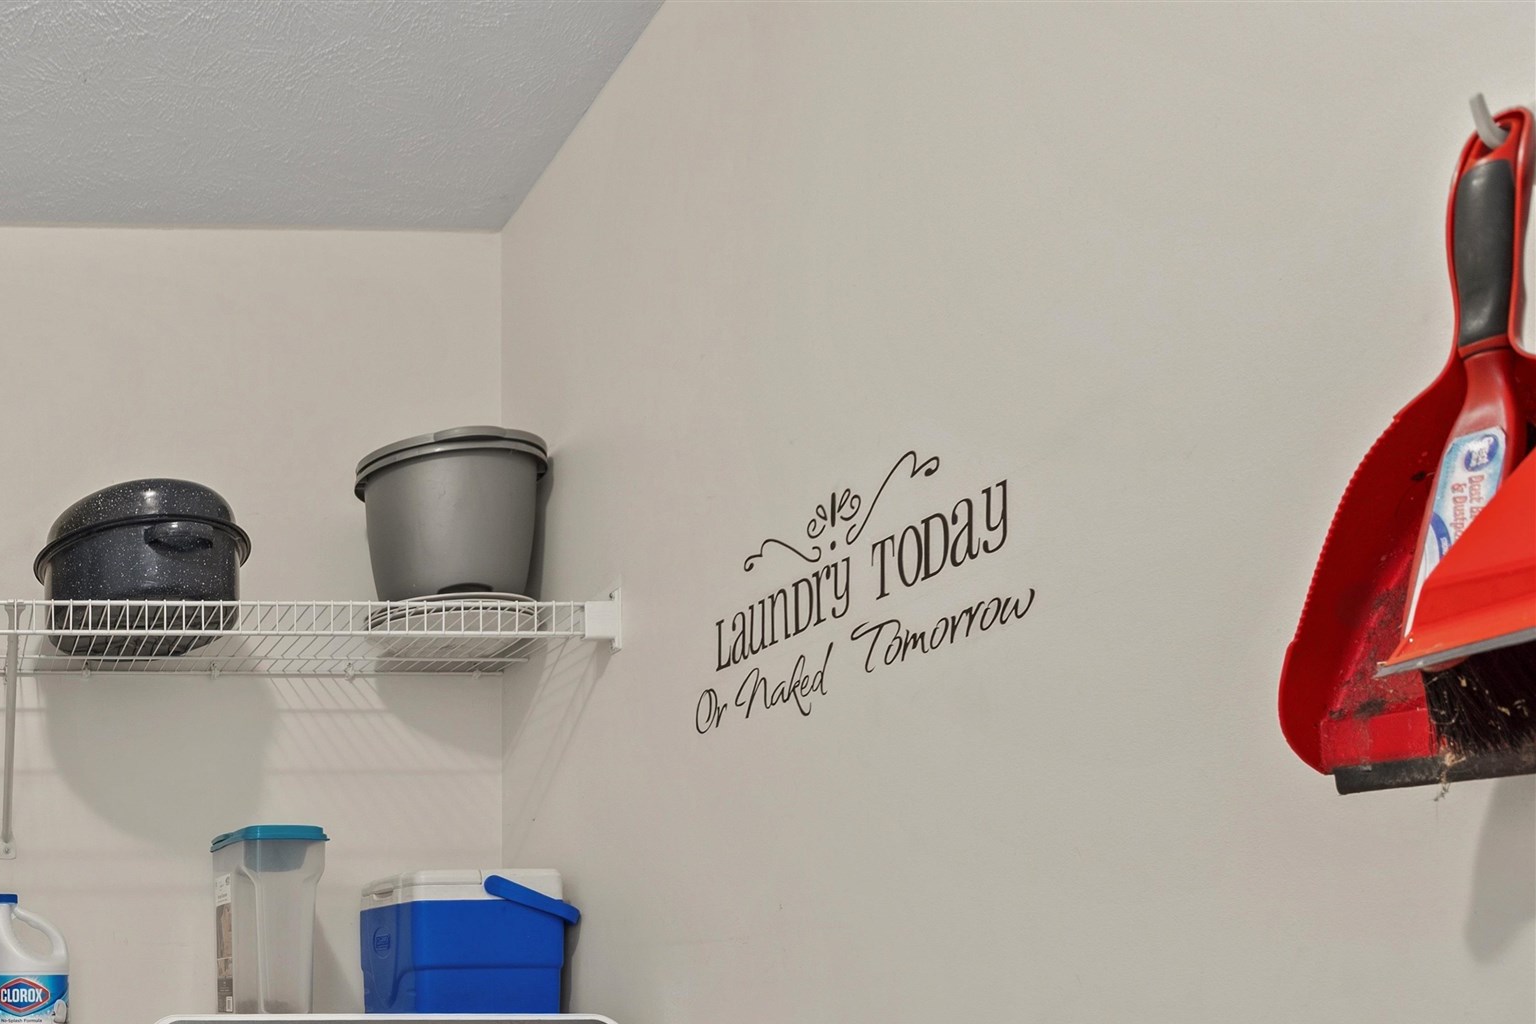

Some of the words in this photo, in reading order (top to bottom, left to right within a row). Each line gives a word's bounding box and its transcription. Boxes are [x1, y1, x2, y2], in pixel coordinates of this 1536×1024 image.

[1451, 483, 1467, 493] &
[1468, 475, 1484, 503] Dust
[1450, 495, 1468, 540] Dustpa
[695, 688, 728, 735] Or
[734, 641, 834, 717] Naked
[850, 588, 1036, 673] Tomorrow
[0, 988, 42, 1003] CLOROX
